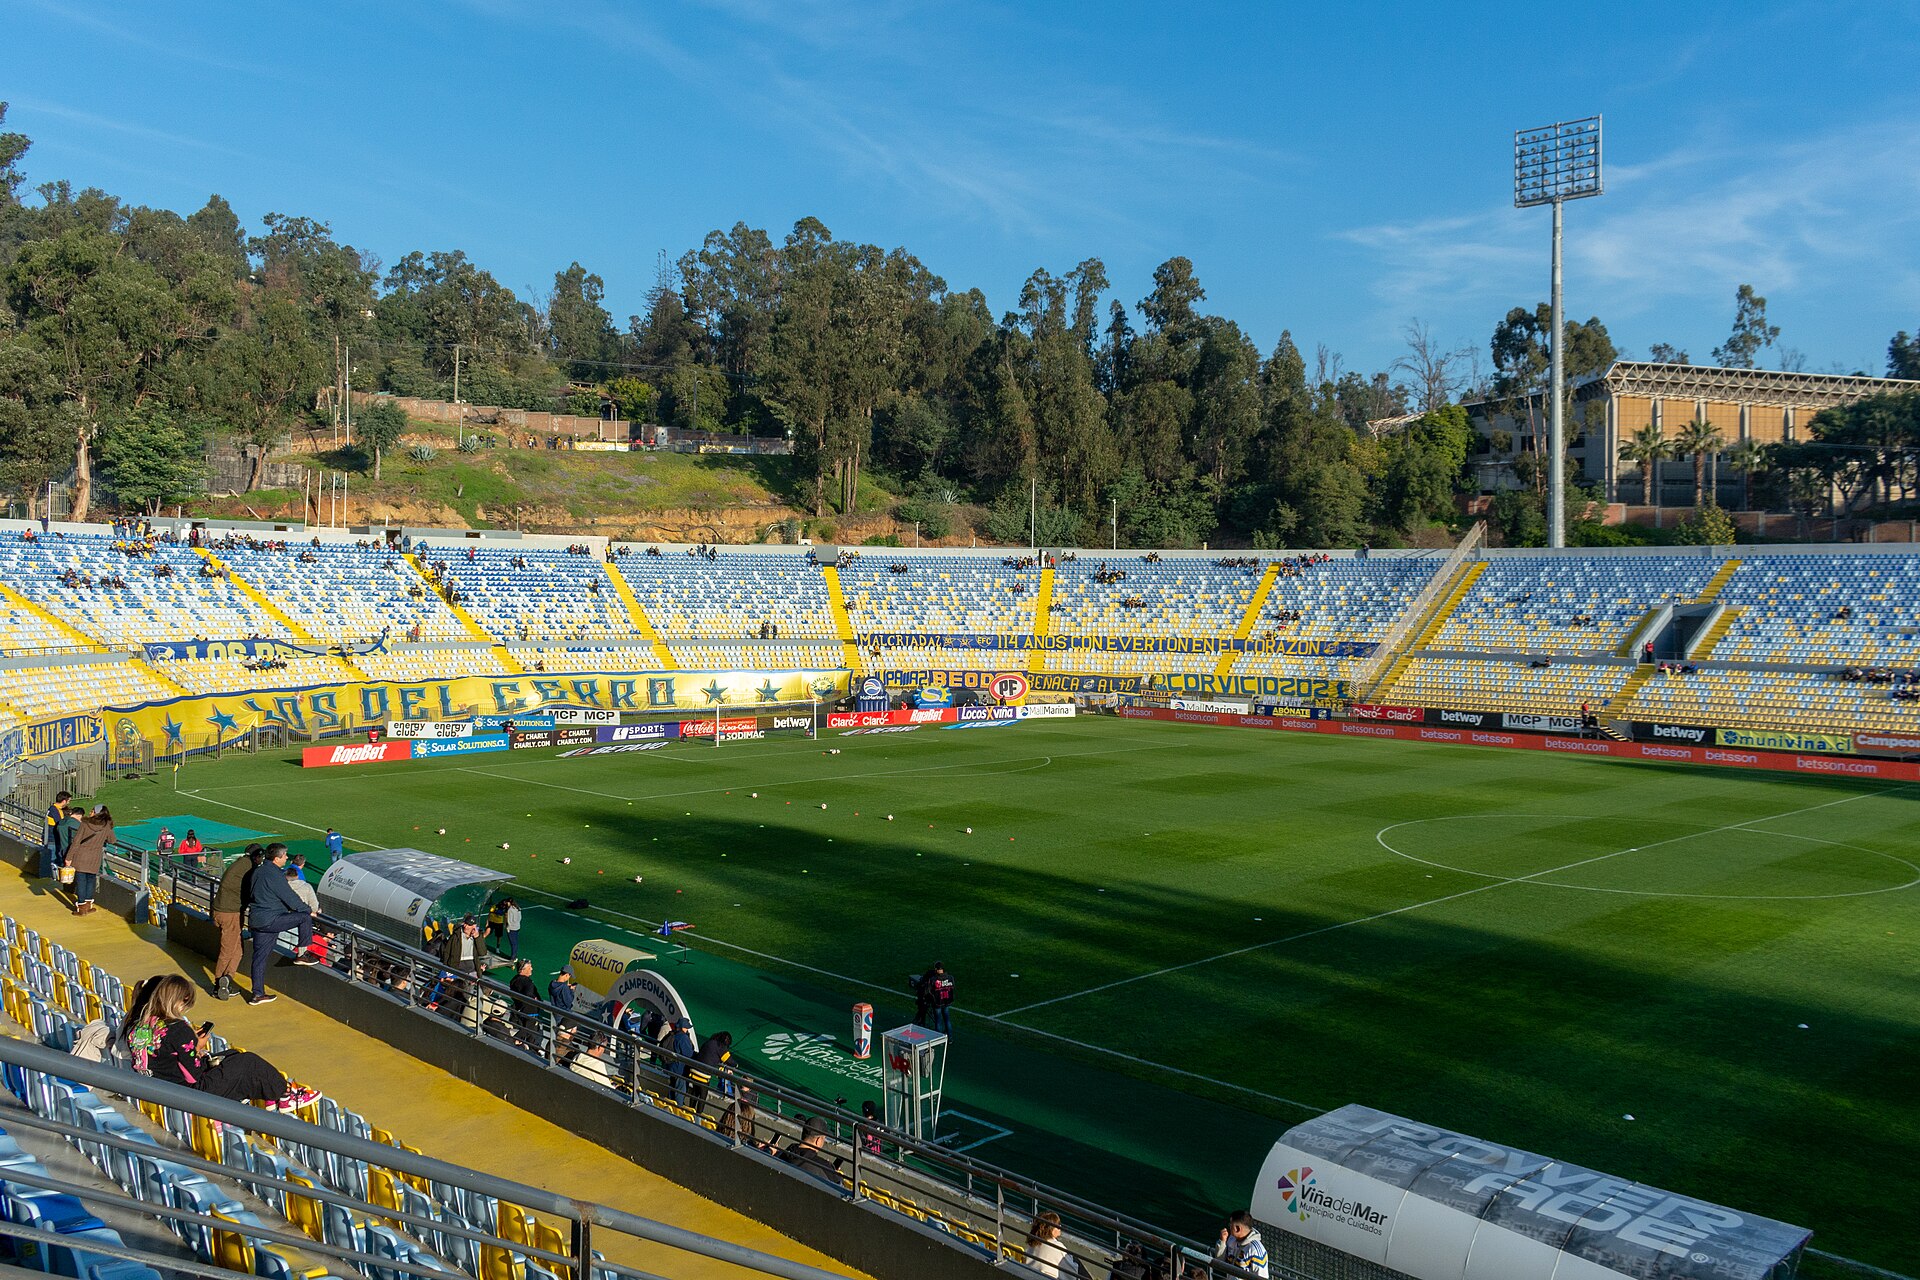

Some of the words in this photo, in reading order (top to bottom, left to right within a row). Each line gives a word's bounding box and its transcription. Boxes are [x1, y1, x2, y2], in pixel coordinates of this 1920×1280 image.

[997, 635, 1018, 649] 114
[1071, 636, 1103, 650] CON
[1106, 636, 1188, 652] EVERTON
[1192, 638, 1215, 653] EN
[1218, 638, 1240, 653] EL
[1244, 639, 1320, 655] CORAZON
[999, 679, 1018, 696] PF
[359, 685, 469, 724] DEL
[488, 677, 676, 713] CERRO
[548, 710, 578, 720] MCP
[584, 710, 615, 721] MCP
[1123, 707, 1154, 717] betsson
[1272, 705, 1310, 716] ABÓNATE
[773, 717, 812, 729] betway
[1175, 711, 1218, 723] betsson.com
[1240, 716, 1274, 726] betsson
[1441, 710, 1483, 726] betway
[1508, 714, 1541, 725] MCP
[393, 722, 426, 732] energy
[434, 723, 467, 733] energy
[628, 724, 665, 735] SPORTS
[1282, 718, 1317, 729] betsson
[1342, 723, 1395, 736] betsson.com
[28, 721, 64, 755] SANTA
[526, 732, 549, 740] CHARLY
[569, 729, 591, 738] CHARLY
[726, 730, 765, 740] SODIMAC
[1421, 729, 1461, 740] betsson
[1472, 732, 1514, 744] betsson
[1653, 724, 1706, 742] betway
[431, 742, 457, 753] SOLAR
[457, 739, 507, 750] SOLUTIONS.CL
[514, 740, 551, 750] CHARLY.COM
[557, 737, 593, 746] CHARLY.COM
[1545, 738, 1609, 752] betsson.com
[330, 743, 388, 765] RojaBet
[1641, 745, 1691, 758] betsson
[1705, 750, 1758, 763] betsson
[1796, 757, 1877, 773] betsson.com
[571, 948, 624, 975] SAUSALITO
[618, 977, 676, 1016] CAMPEONATO
[1361, 1118, 1743, 1236] POWER
[1299, 1201, 1335, 1219] Municipio
[1335, 1213, 1346, 1223] de
[1346, 1219, 1383, 1236] Cuidados
[1463, 1172, 1709, 1258] ADE
